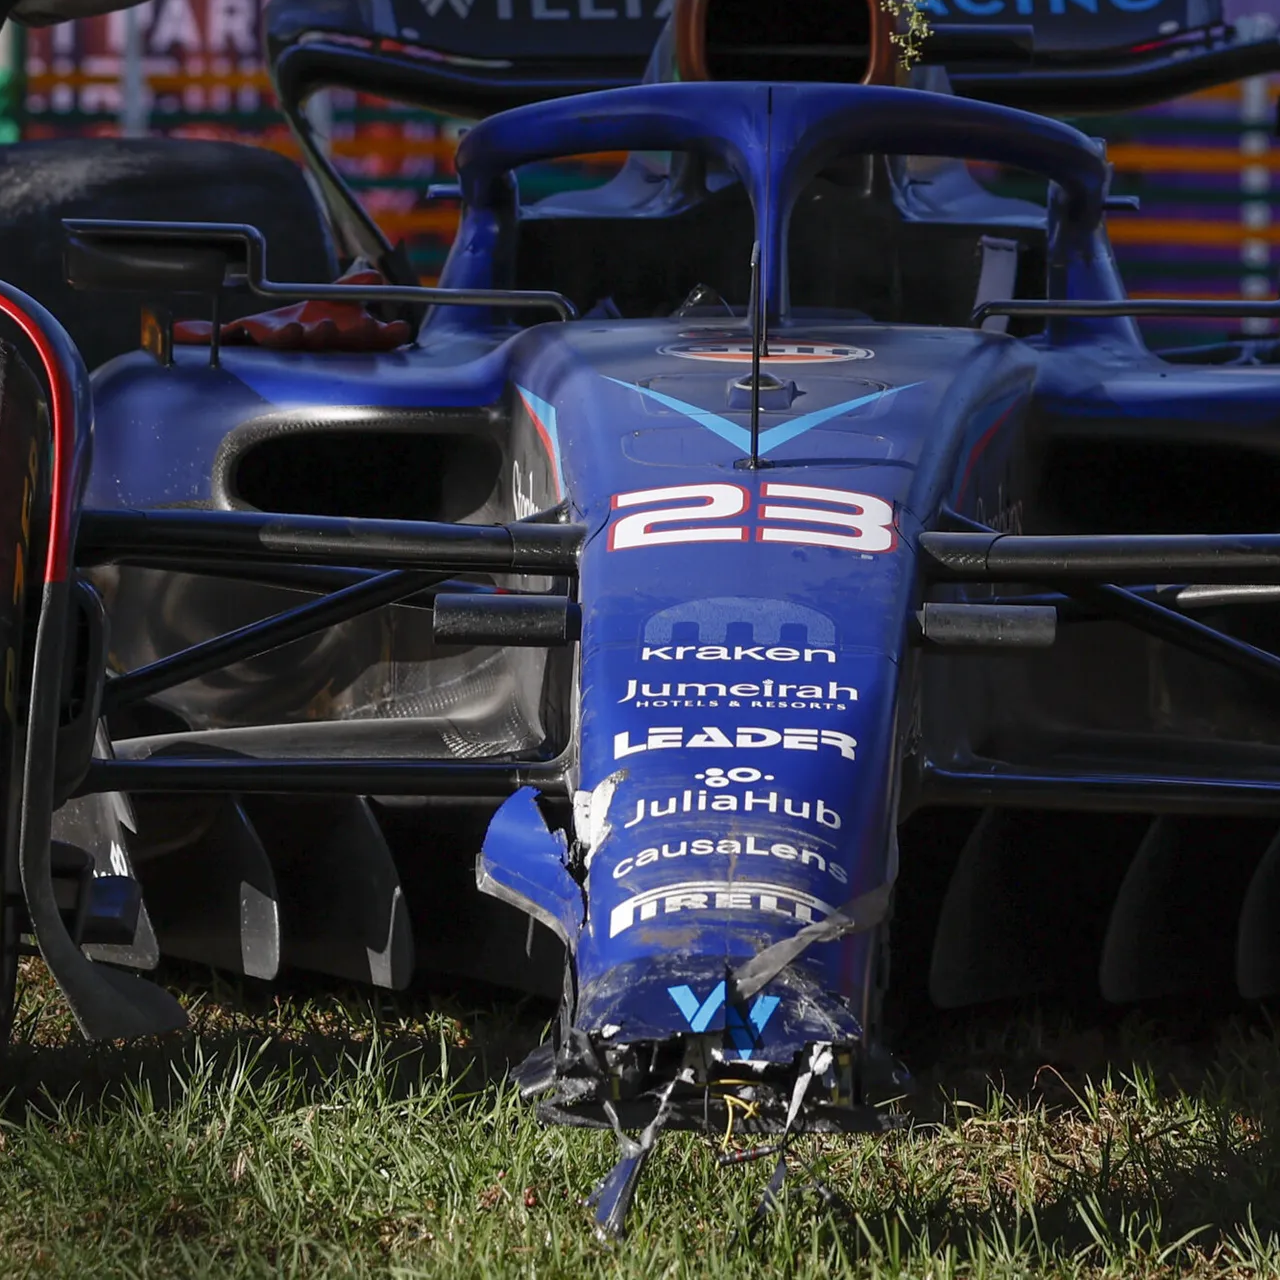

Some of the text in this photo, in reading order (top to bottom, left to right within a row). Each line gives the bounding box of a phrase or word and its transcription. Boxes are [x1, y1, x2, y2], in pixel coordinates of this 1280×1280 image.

[606, 481, 898, 553] 23
[641, 645, 836, 663] kraken
[617, 678, 859, 703] Jumeirah
[636, 699, 847, 711] HOTELS & RESORTS
[613, 725, 858, 761] LEADER
[624, 789, 842, 830] JuliaHub
[613, 836, 848, 884] causaLens
